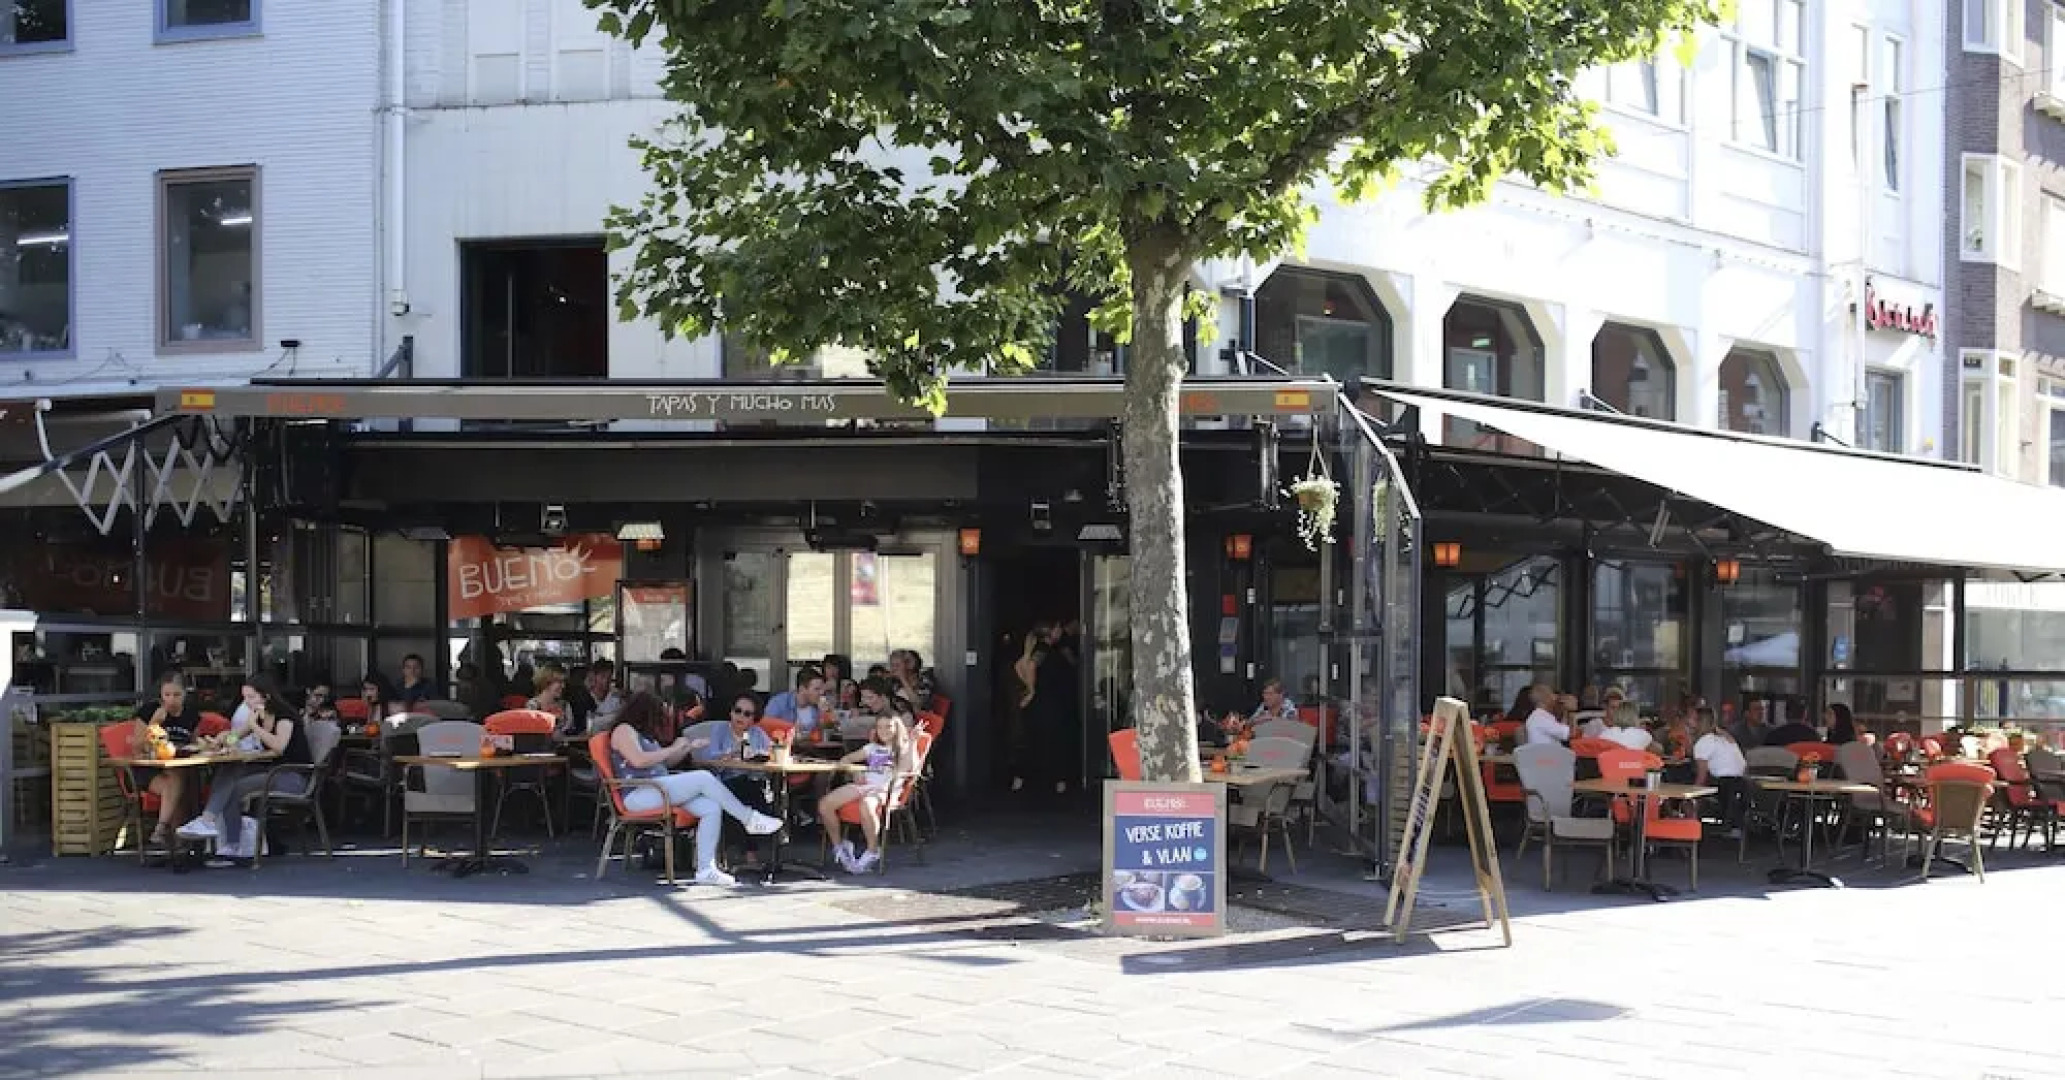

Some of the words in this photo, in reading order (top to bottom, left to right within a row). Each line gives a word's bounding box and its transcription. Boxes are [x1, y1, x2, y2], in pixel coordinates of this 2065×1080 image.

[646, 392, 697, 416] TAPAS
[708, 394, 722, 414] Y
[801, 392, 836, 412] MAS
[459, 546, 586, 600] BUENO
[1124, 823, 1162, 843] VERSE
[1164, 820, 1205, 840] KOFFIE
[1142, 849, 1153, 866] &
[1156, 846, 1192, 864] VLAAI
